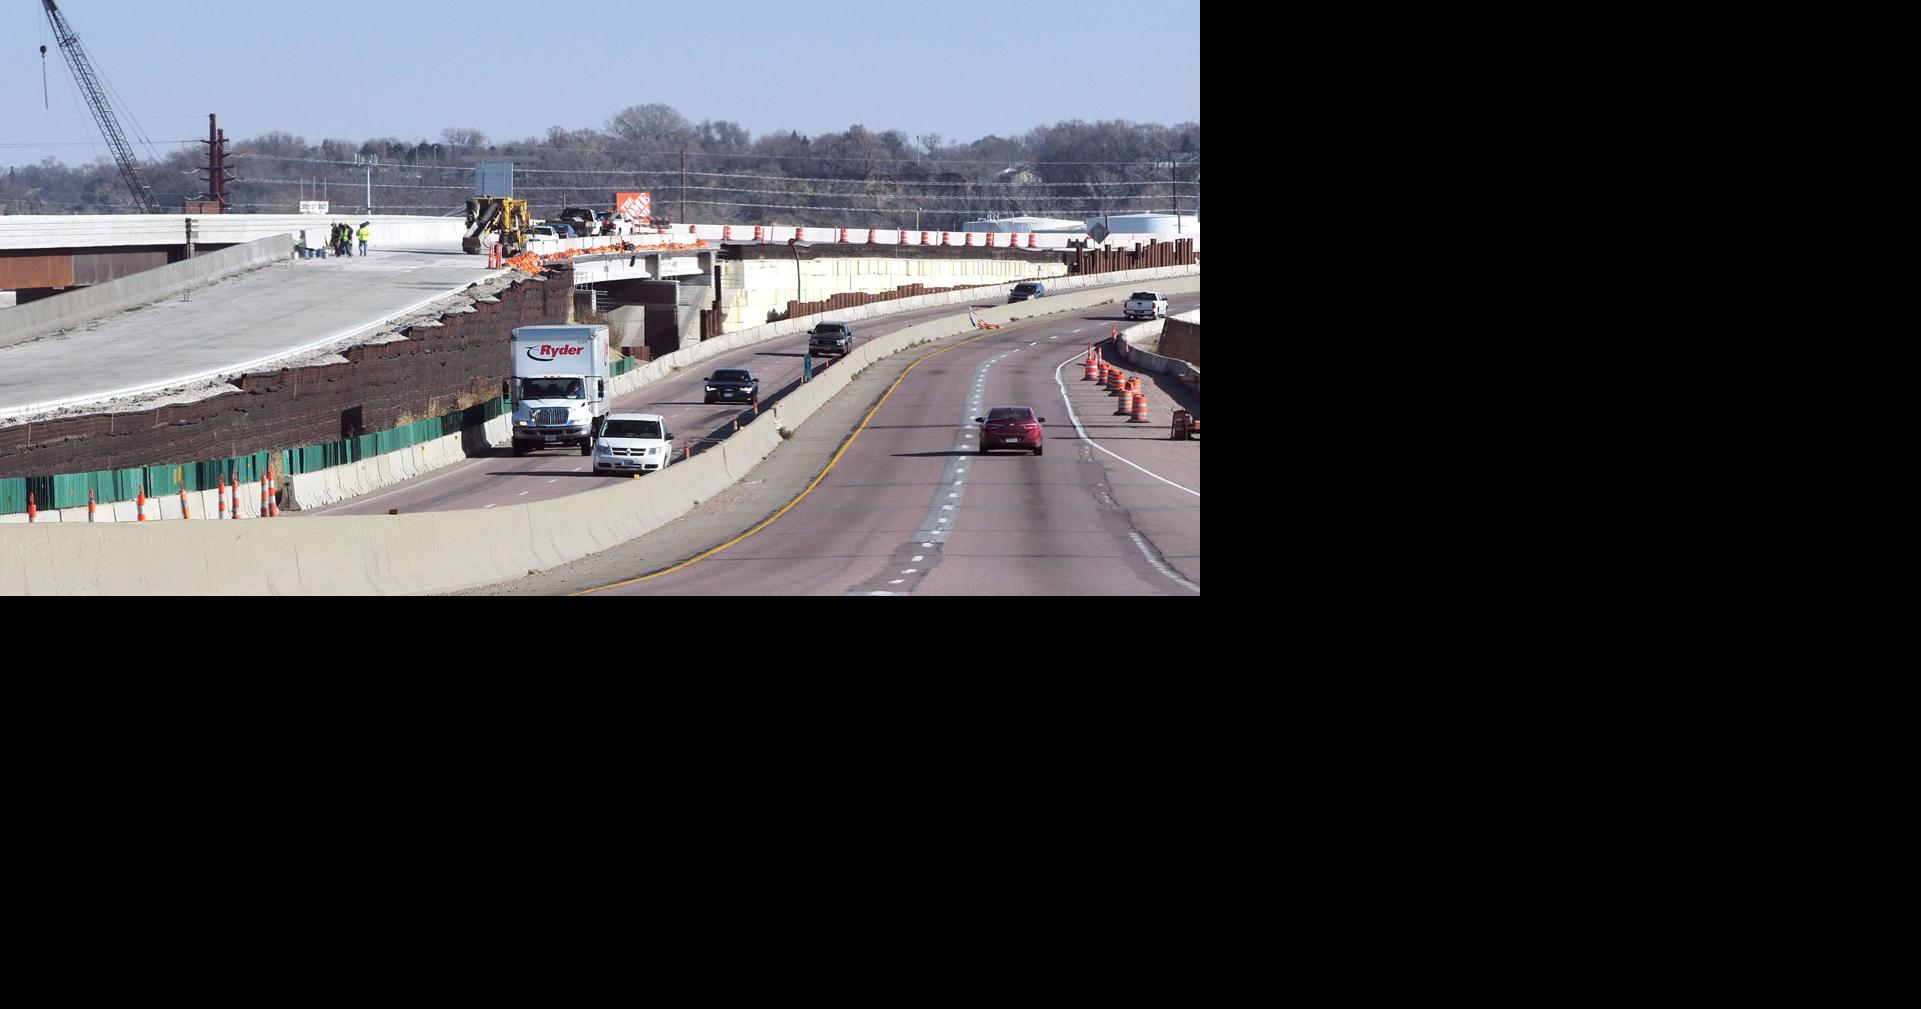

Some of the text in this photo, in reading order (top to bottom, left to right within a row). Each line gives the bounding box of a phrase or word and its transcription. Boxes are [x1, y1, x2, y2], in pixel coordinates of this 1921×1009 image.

[620, 196, 635, 211] THE
[624, 192, 651, 220] HOME
[540, 344, 584, 358] Ryder
